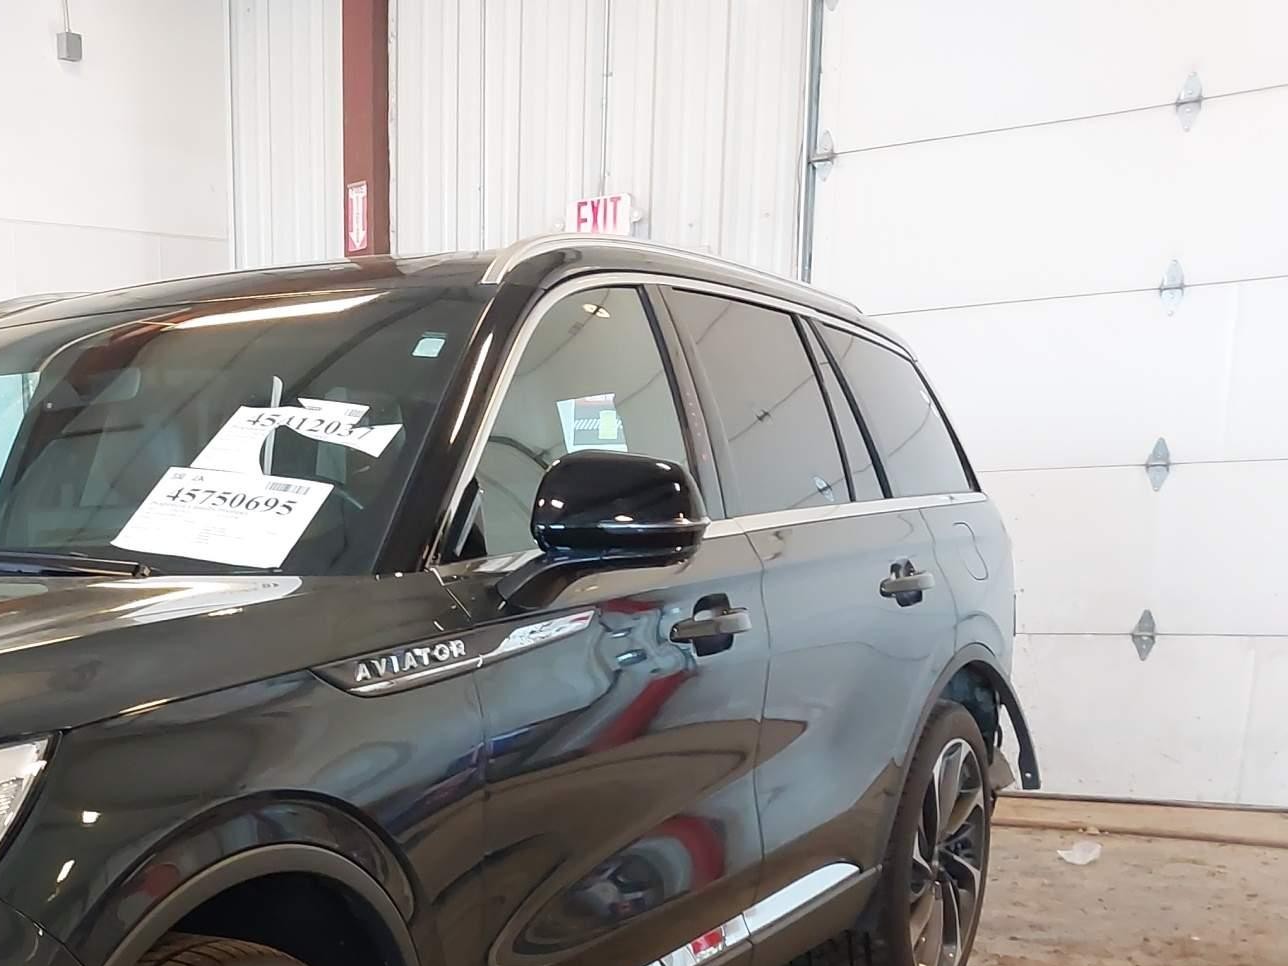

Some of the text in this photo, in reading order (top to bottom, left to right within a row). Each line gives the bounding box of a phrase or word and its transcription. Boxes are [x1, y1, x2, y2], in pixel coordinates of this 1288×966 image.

[576, 196, 622, 233] EXIT
[165, 487, 299, 516] 45750695
[355, 639, 466, 682] AVIATOR
